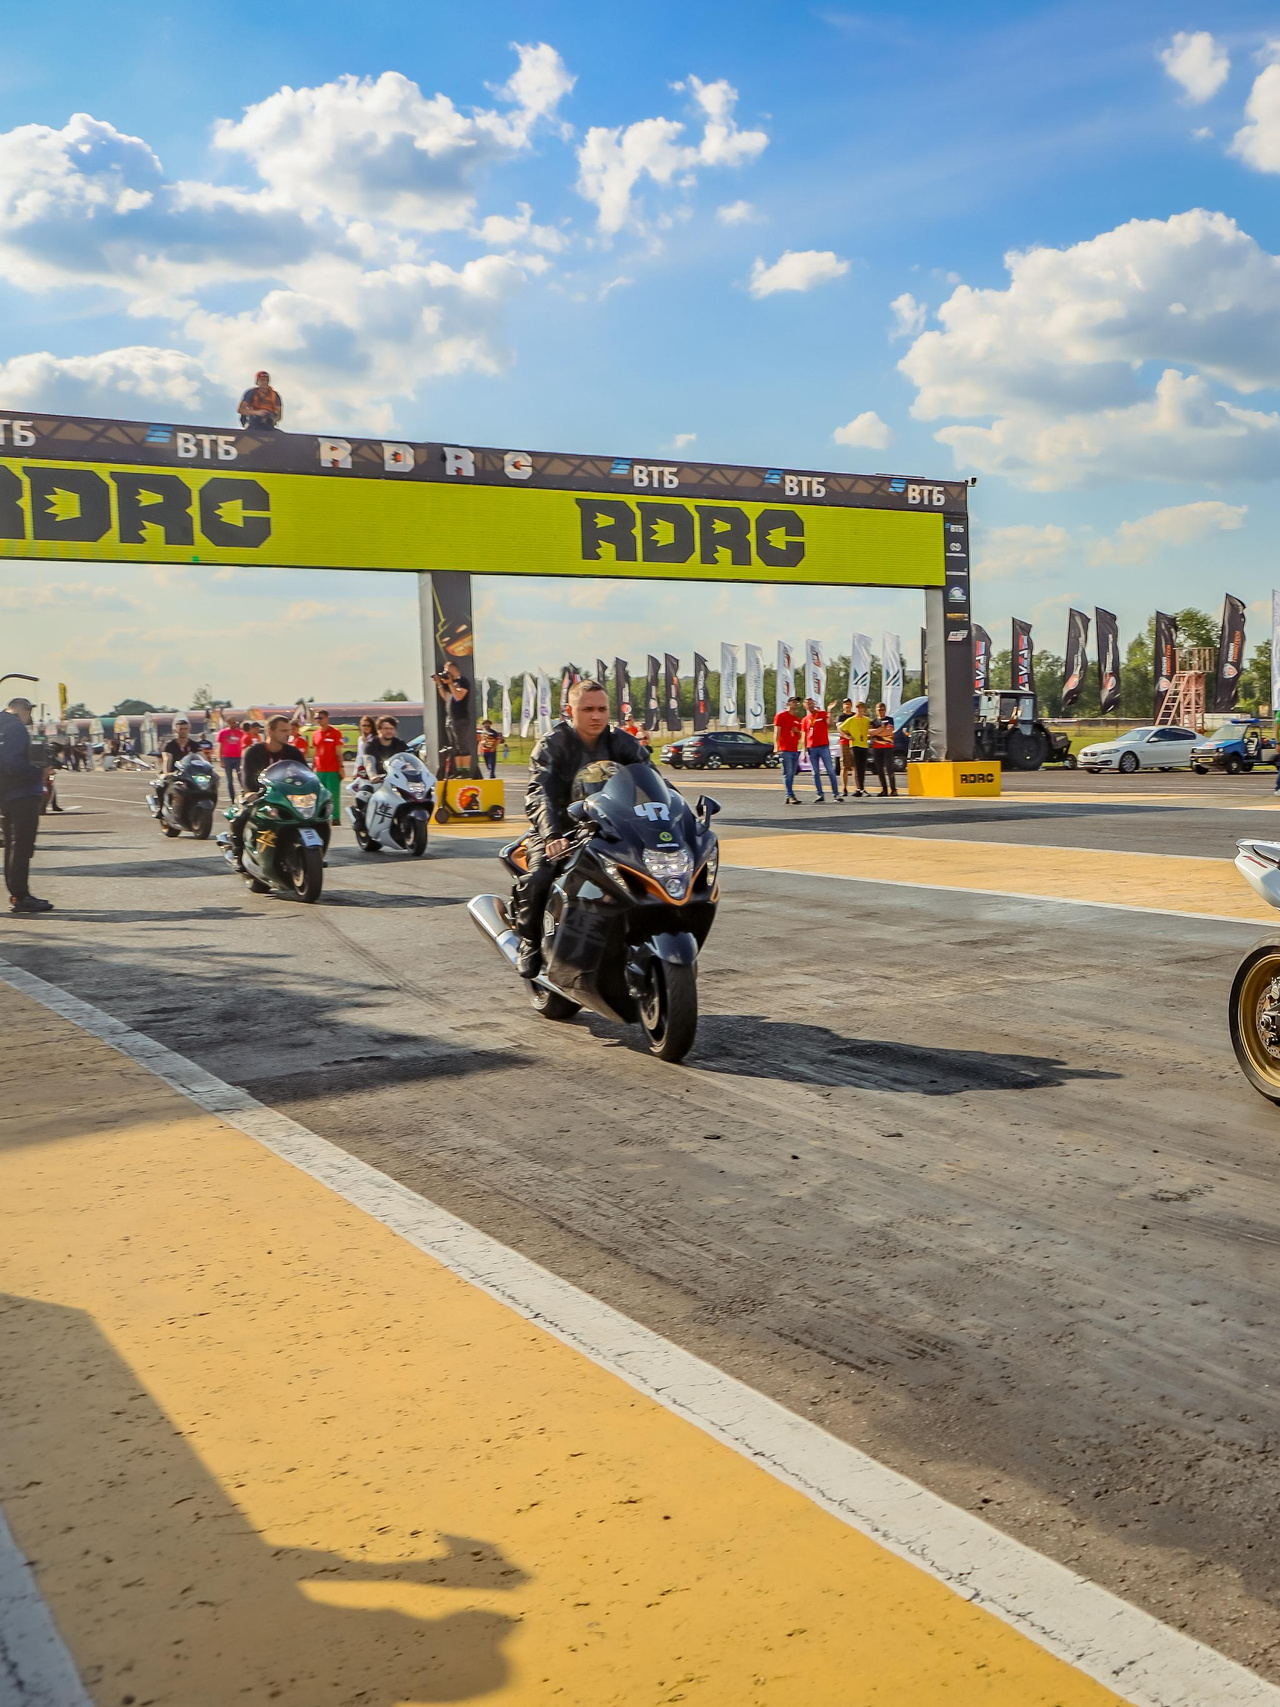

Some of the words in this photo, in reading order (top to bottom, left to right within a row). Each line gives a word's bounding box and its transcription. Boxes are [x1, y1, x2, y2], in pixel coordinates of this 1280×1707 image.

[0, 419, 37, 447] ТБ
[176, 432, 239, 461] ВТБ
[633, 465, 680, 489] ВТБ
[784, 474, 827, 499] ВТБ
[907, 484, 946, 507] ВТБ
[575, 497, 806, 568] RDRC
[960, 773, 994, 784] RDRC
